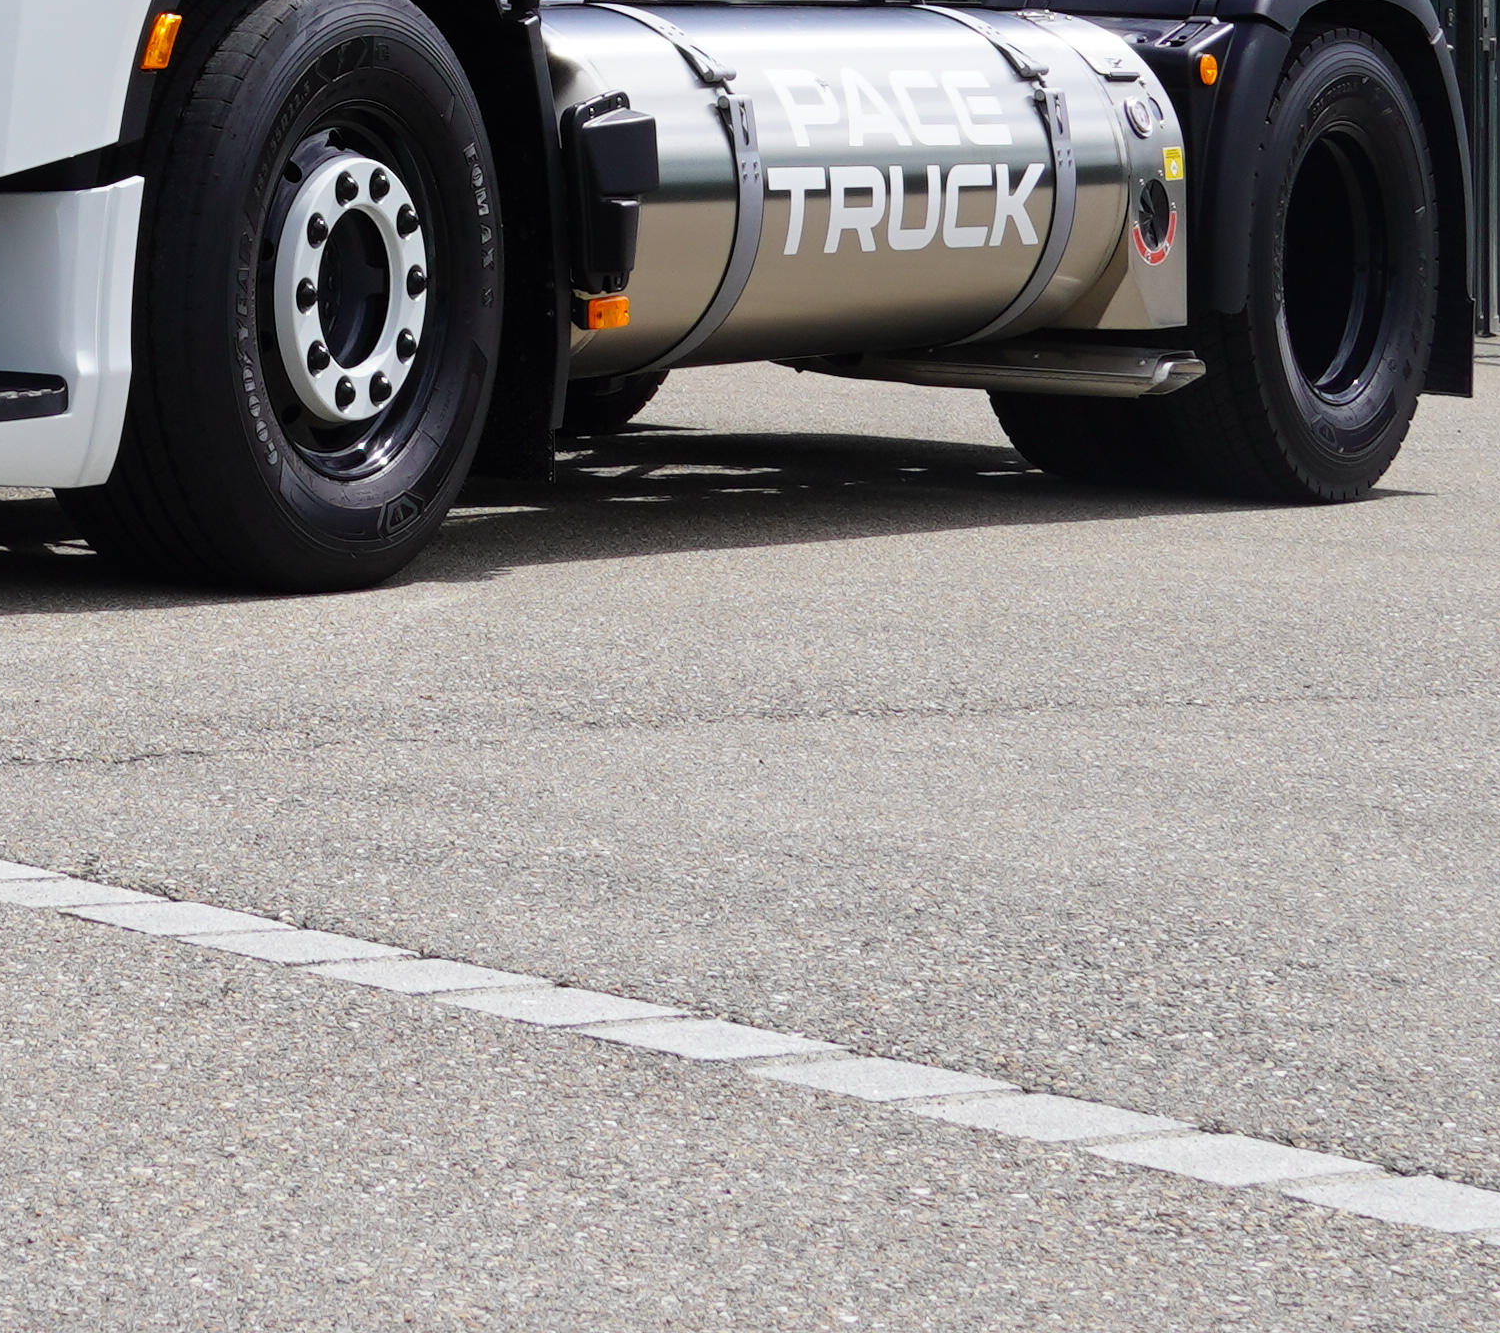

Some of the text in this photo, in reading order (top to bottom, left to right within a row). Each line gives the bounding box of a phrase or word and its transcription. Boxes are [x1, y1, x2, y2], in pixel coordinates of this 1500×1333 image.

[762, 67, 1013, 147] PACE
[767, 163, 1046, 255] TRUCK
[234, 231, 279, 466] GOODYEAR
